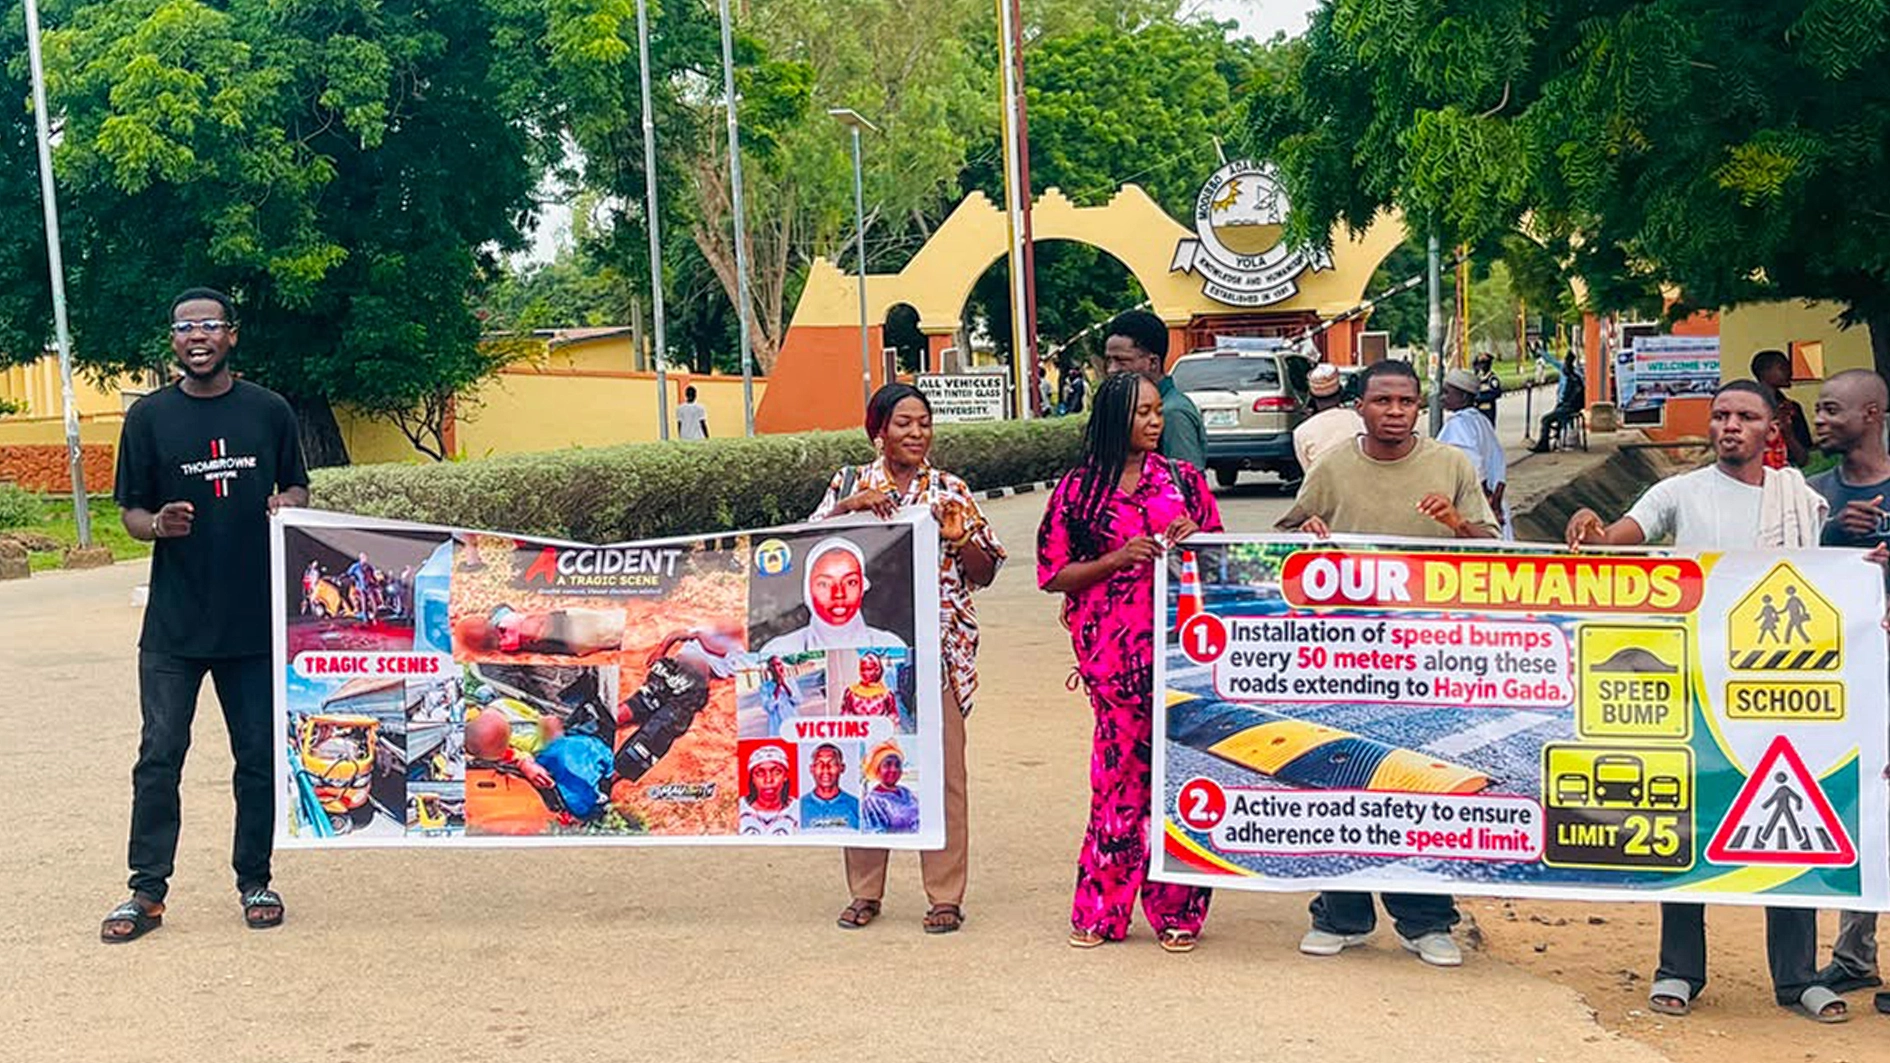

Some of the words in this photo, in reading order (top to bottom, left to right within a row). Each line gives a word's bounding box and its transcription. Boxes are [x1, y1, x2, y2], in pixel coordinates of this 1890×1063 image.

[1236, 257, 1267, 268] YOLA
[1209, 285, 1259, 303] ESTABLISHED
[1262, 294, 1271, 302] IN
[1648, 361, 1700, 371] WELCOME
[919, 379, 942, 388] ALL
[944, 379, 1001, 388] VEHICLES
[525, 548, 683, 584] ACCIDENT
[557, 576, 567, 585] A
[570, 576, 617, 585] TRAGIC
[620, 576, 660, 585] SCENE
[1303, 558, 1410, 602] OUR
[1424, 559, 1683, 608] DEMANDS
[1192, 624, 1217, 655] 1.
[1231, 620, 1357, 644] Installation
[1362, 622, 1386, 644] of
[1391, 625, 1462, 650] speed
[1469, 626, 1553, 652] bumps
[304, 656, 369, 673] TRAGIC
[376, 657, 440, 674] SCENES
[1231, 651, 1292, 674] every
[1297, 647, 1327, 669] 50
[1333, 649, 1417, 671] meters
[1423, 650, 1489, 676] along
[1494, 651, 1558, 674] these
[1229, 673, 1288, 694] roads
[1294, 675, 1401, 700] extending
[1405, 677, 1430, 697] to
[1434, 677, 1497, 704] Hayin
[1502, 678, 1567, 701] Gada.
[1599, 681, 1671, 702] SPEED
[1736, 689, 1836, 713] SCHOOL
[1602, 704, 1669, 725] BUMP
[795, 720, 870, 738] VICTIMS
[1187, 788, 1219, 820] 2.
[1233, 795, 1300, 818] Active
[1307, 797, 1355, 818] road
[1359, 799, 1427, 825] safety
[1432, 802, 1454, 821] to
[1459, 807, 1532, 824] ensure
[1225, 823, 1335, 845] adherence
[1340, 826, 1362, 845] to
[1367, 825, 1401, 846] the
[1405, 828, 1474, 856] speed
[1478, 828, 1536, 852] limit.
[1557, 824, 1619, 846] LIMIT
[1624, 816, 1681, 856] 25
